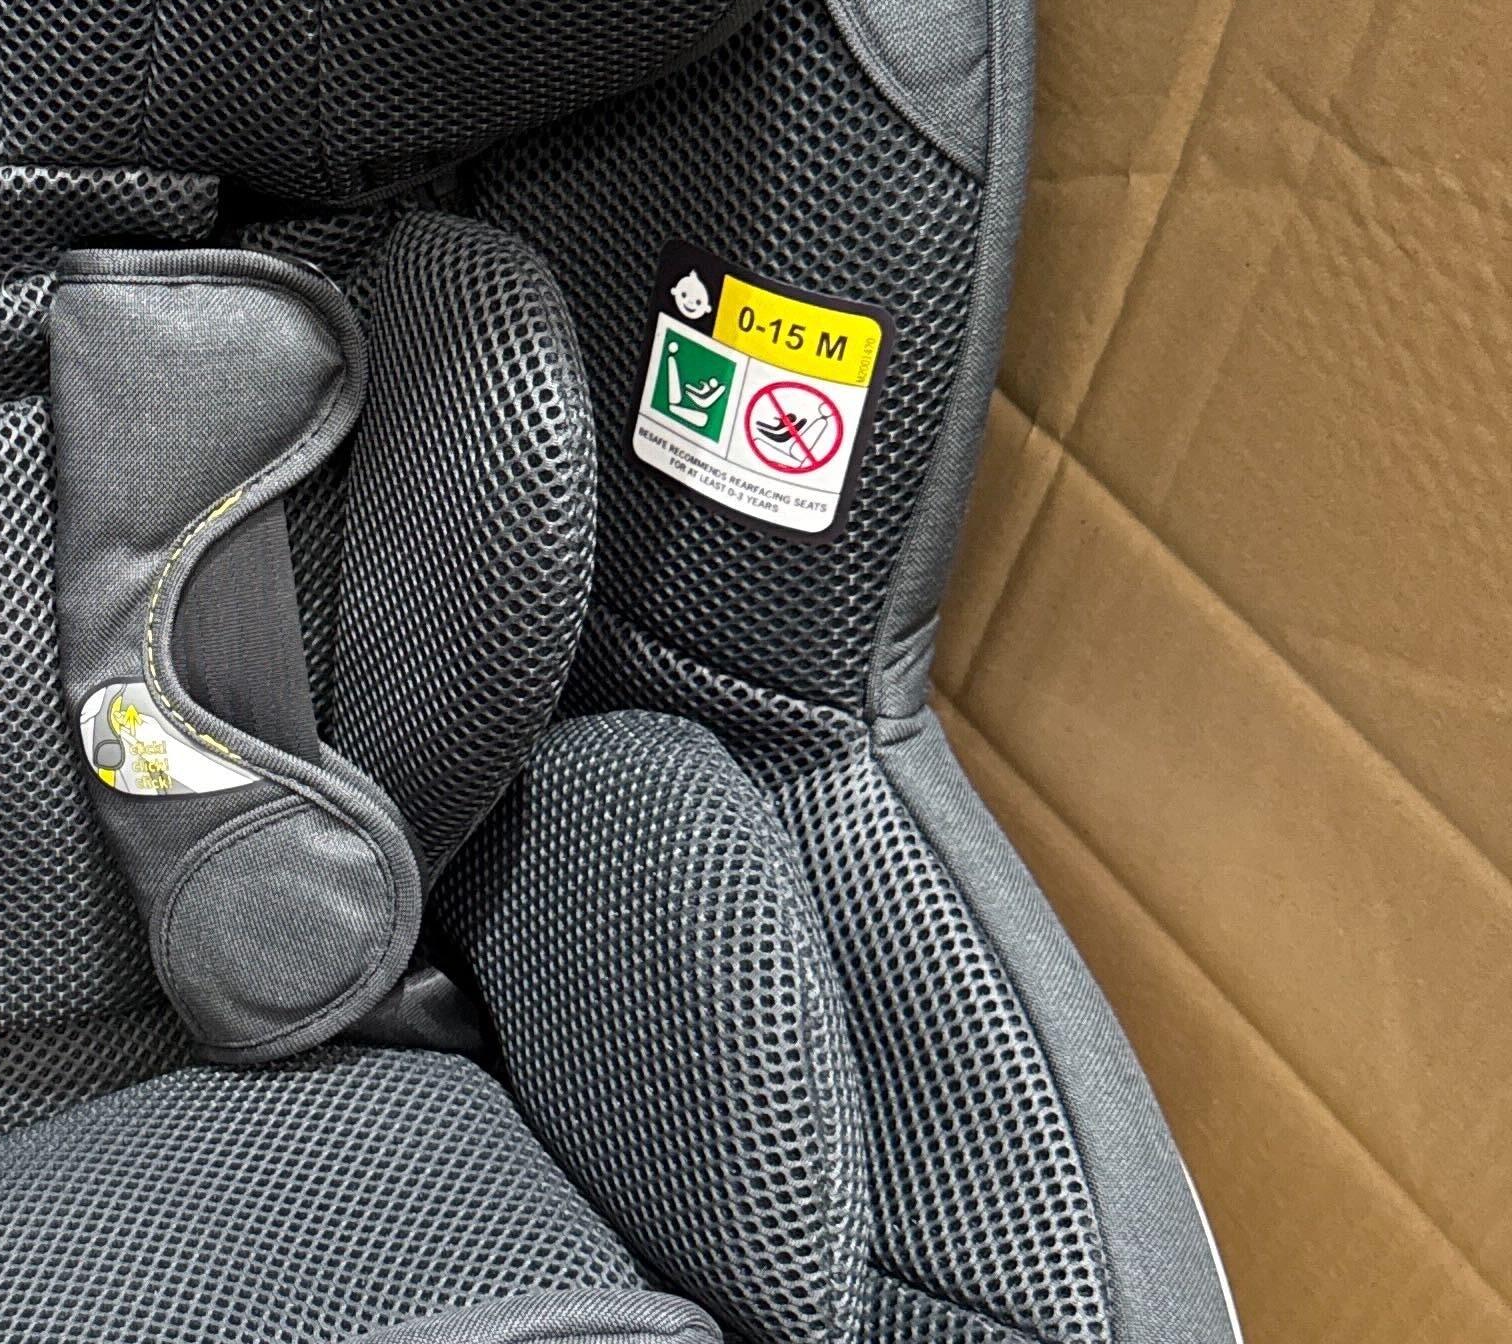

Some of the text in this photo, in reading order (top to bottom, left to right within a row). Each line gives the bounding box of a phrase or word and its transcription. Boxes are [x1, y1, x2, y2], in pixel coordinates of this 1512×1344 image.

[738, 306, 848, 362] 0-15 M
[638, 427, 827, 513] BESAFE RECOMMENDS REARFACING SEATS
[669, 457, 779, 513] FOR AT LEAST 0-3 YEARS
